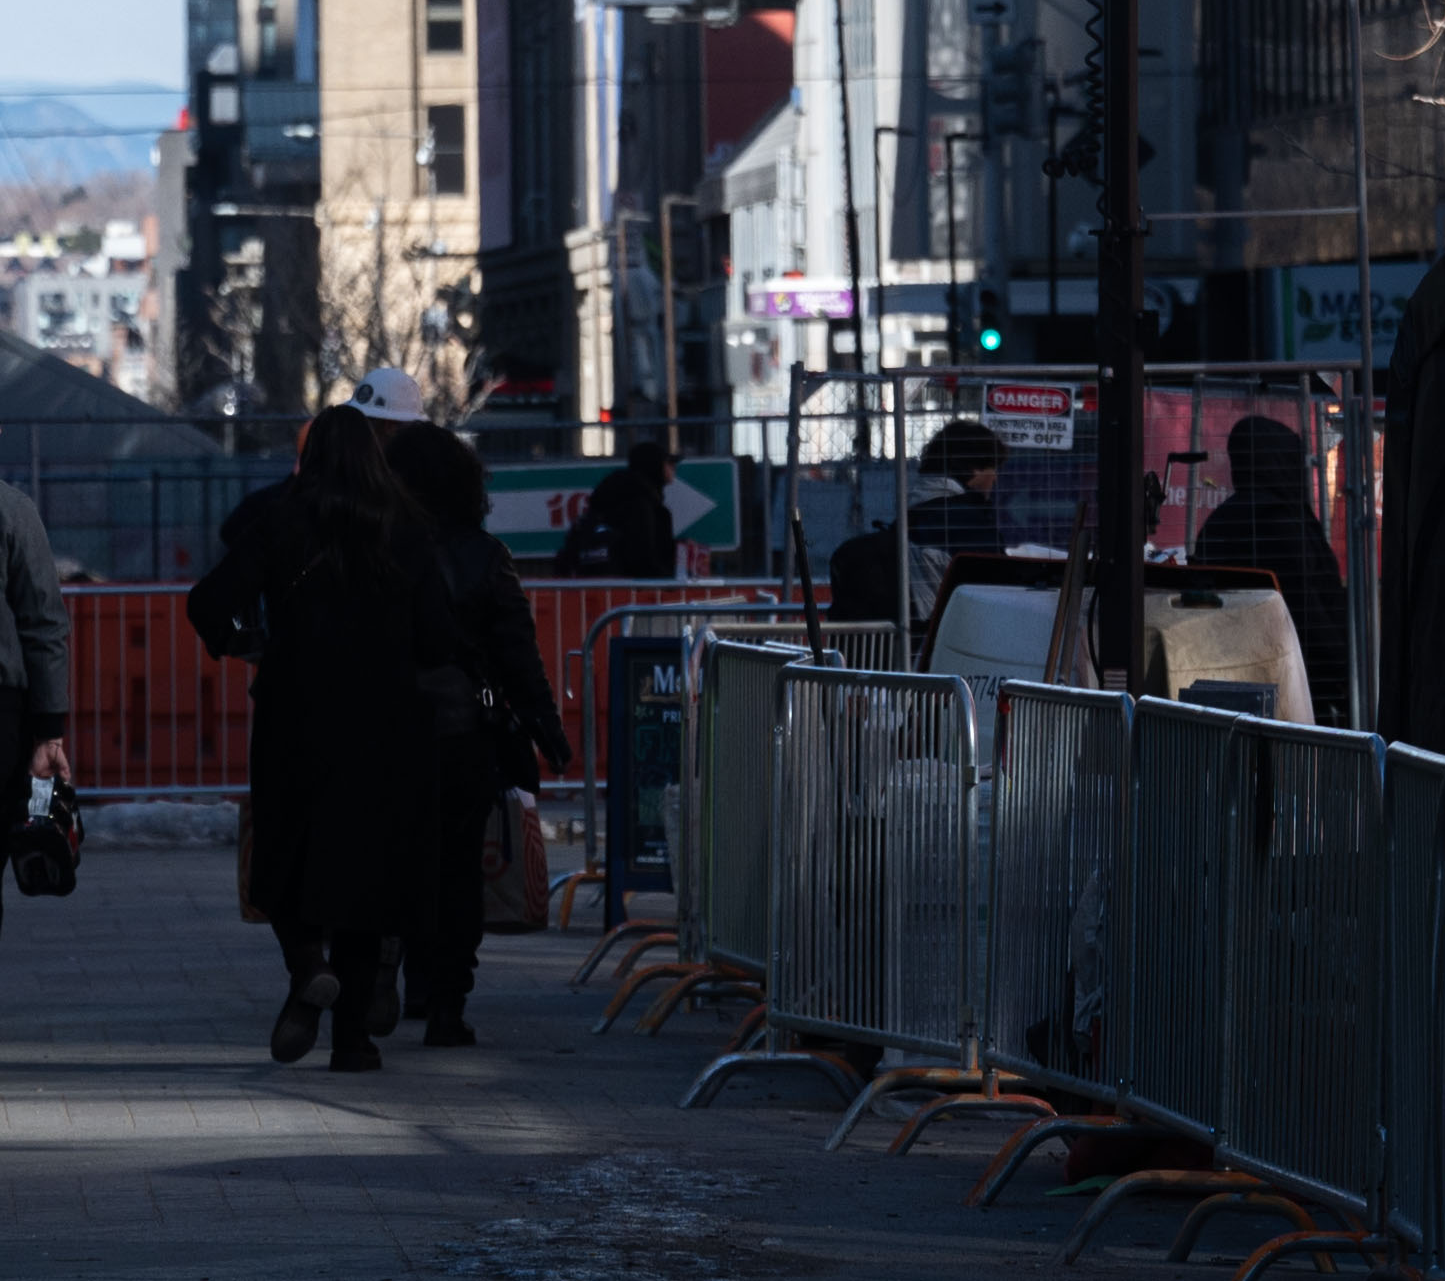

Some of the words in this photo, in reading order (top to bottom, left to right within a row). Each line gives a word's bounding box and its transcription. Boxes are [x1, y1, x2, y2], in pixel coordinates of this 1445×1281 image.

[993, 392, 1064, 411] DANGER
[999, 431, 1030, 443] EEP
[1033, 433, 1064, 445] OUT
